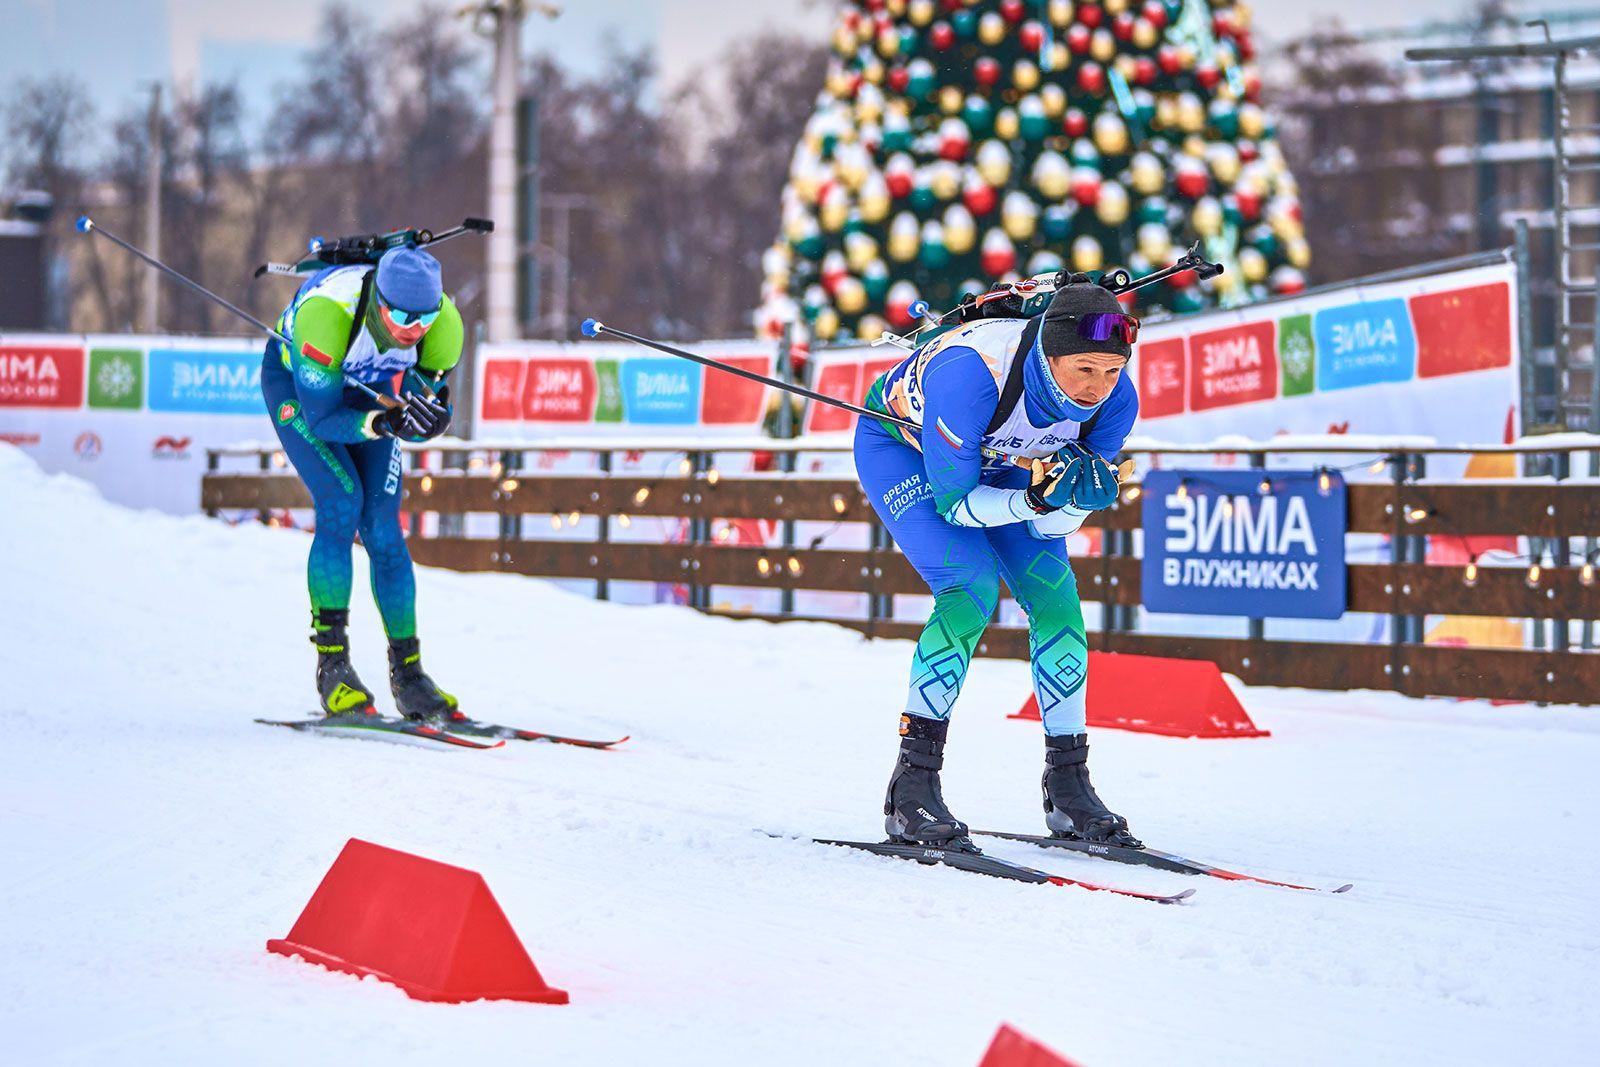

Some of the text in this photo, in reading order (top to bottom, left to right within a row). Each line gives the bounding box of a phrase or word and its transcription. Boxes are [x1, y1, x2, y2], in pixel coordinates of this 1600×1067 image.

[1202, 336, 1262, 376] ЗИМА
[883, 474, 920, 505] ВРЕМЯ
[890, 483, 934, 515] СПОРТА
[1165, 494, 1318, 556] ЗИМА
[1163, 557, 1319, 591] В ЛУЖНИКАХ
[916, 807, 938, 823] ATOMIC
[923, 849, 945, 859] ATOMIC
[1088, 844, 1109, 855] ATOMIC
